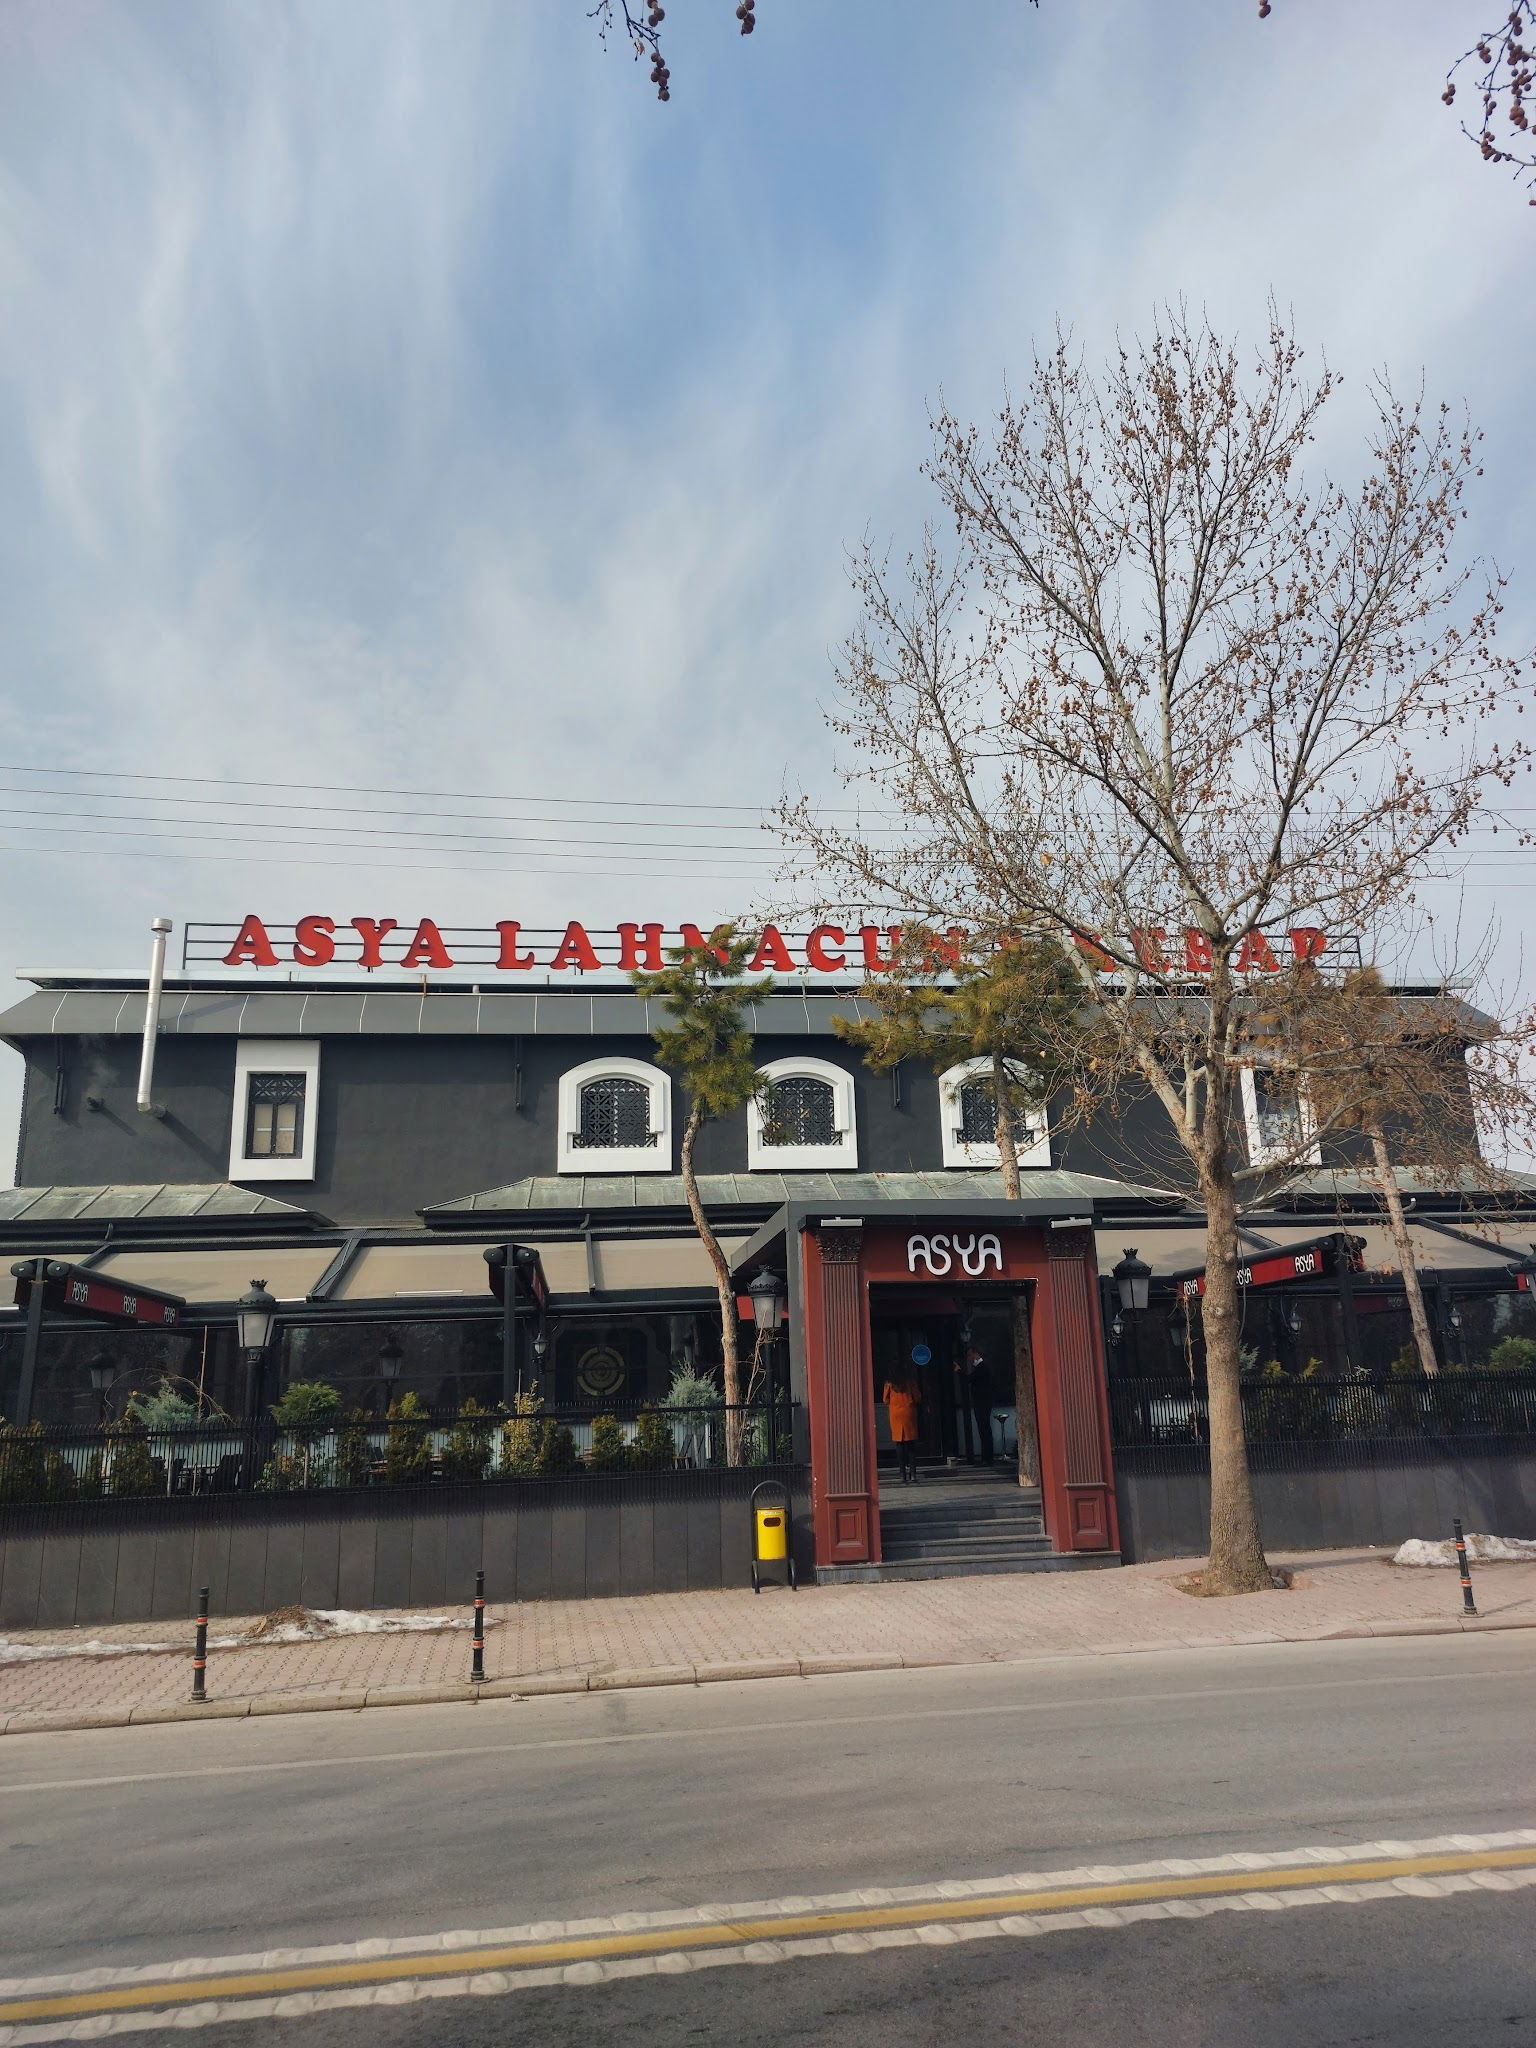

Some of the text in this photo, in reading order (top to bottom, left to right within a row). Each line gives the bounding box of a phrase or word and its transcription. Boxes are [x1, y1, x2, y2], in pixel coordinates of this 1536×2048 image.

[222, 915, 454, 968] ASYA
[496, 920, 969, 973] LAHMACUN
[907, 1233, 1003, 1276] ASYA
[1294, 1253, 1315, 1273] ASYA
[1236, 1267, 1253, 1286] SYA
[72, 1281, 89, 1303] ASYA
[1183, 1279, 1198, 1296] ASYA
